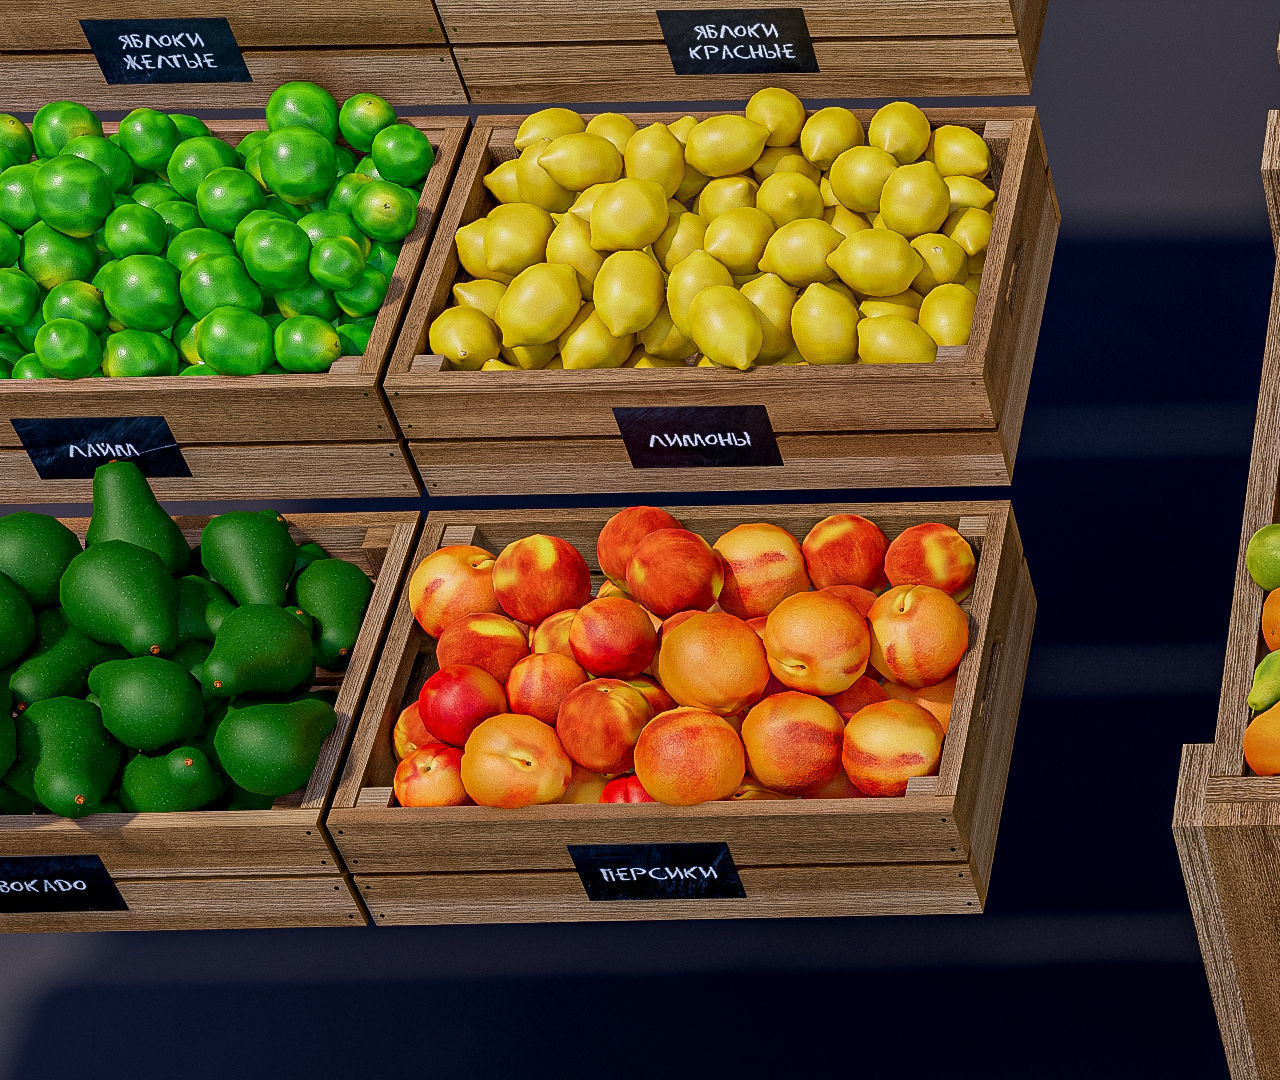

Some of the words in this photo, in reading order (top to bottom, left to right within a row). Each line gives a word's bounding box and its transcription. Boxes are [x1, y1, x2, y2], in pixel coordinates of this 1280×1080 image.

[693, 23, 779, 41] ЯБЛОКИ
[118, 32, 205, 50] ЯБЛОКИ
[688, 43, 797, 60] КРАСНЫЕ
[122, 52, 218, 71] ЖЕЛТЫЕ
[649, 431, 752, 448] ЛИМОНЫ
[69, 442, 140, 458] ЛАЙМ
[599, 866, 718, 882] ПЕРСИКИ
